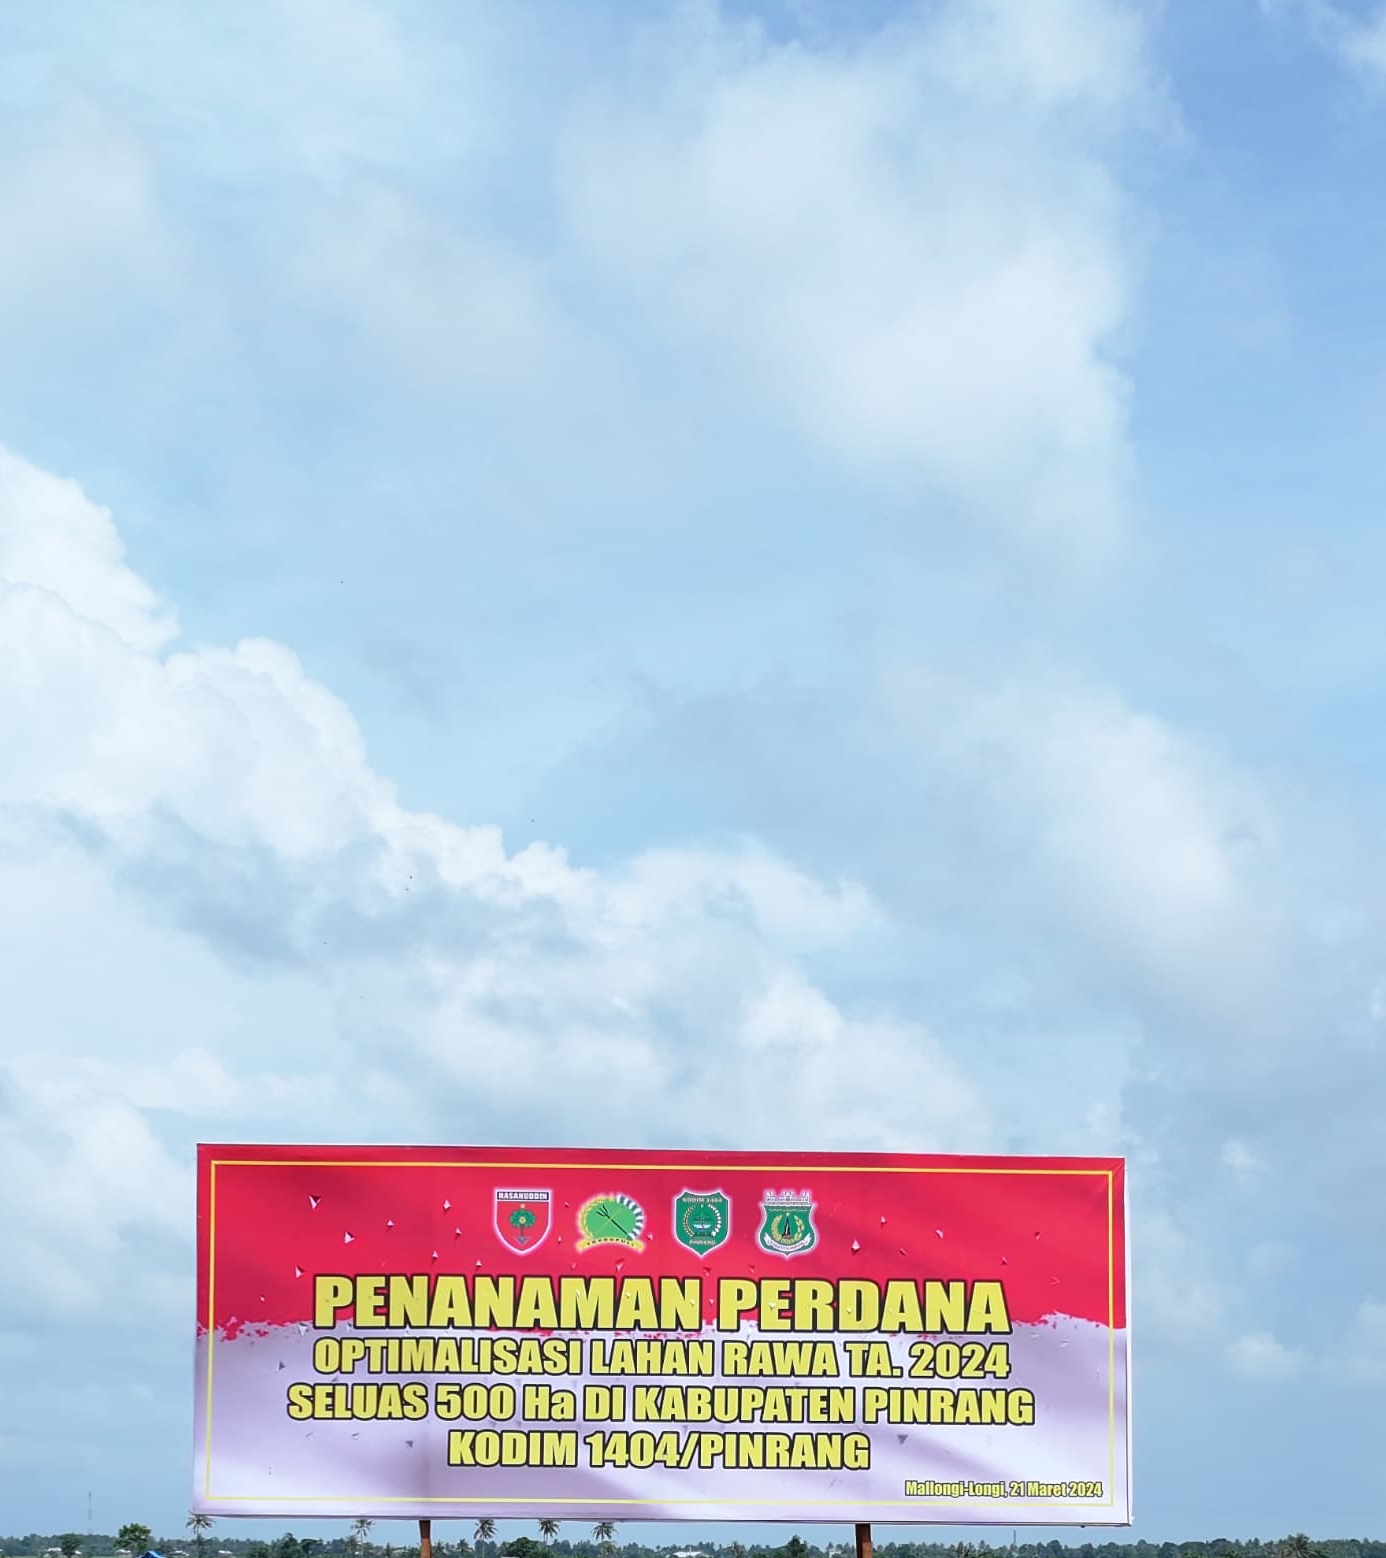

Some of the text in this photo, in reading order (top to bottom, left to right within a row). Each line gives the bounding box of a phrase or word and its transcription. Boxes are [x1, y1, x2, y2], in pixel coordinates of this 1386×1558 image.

[313, 1275, 1013, 1334] PENANAMAN PERDANA
[313, 1336, 1011, 1379] OPTIMALISASI LAHAN RAWA TA. 2024
[287, 1382, 1036, 1425] SELUAS 500 Ha DI KABUPATEN PINRANG
[447, 1429, 871, 1470] KODIM 1404/PINRANG
[905, 1480, 1103, 1498] Mallongi-Longi, 21 Maret 2024
